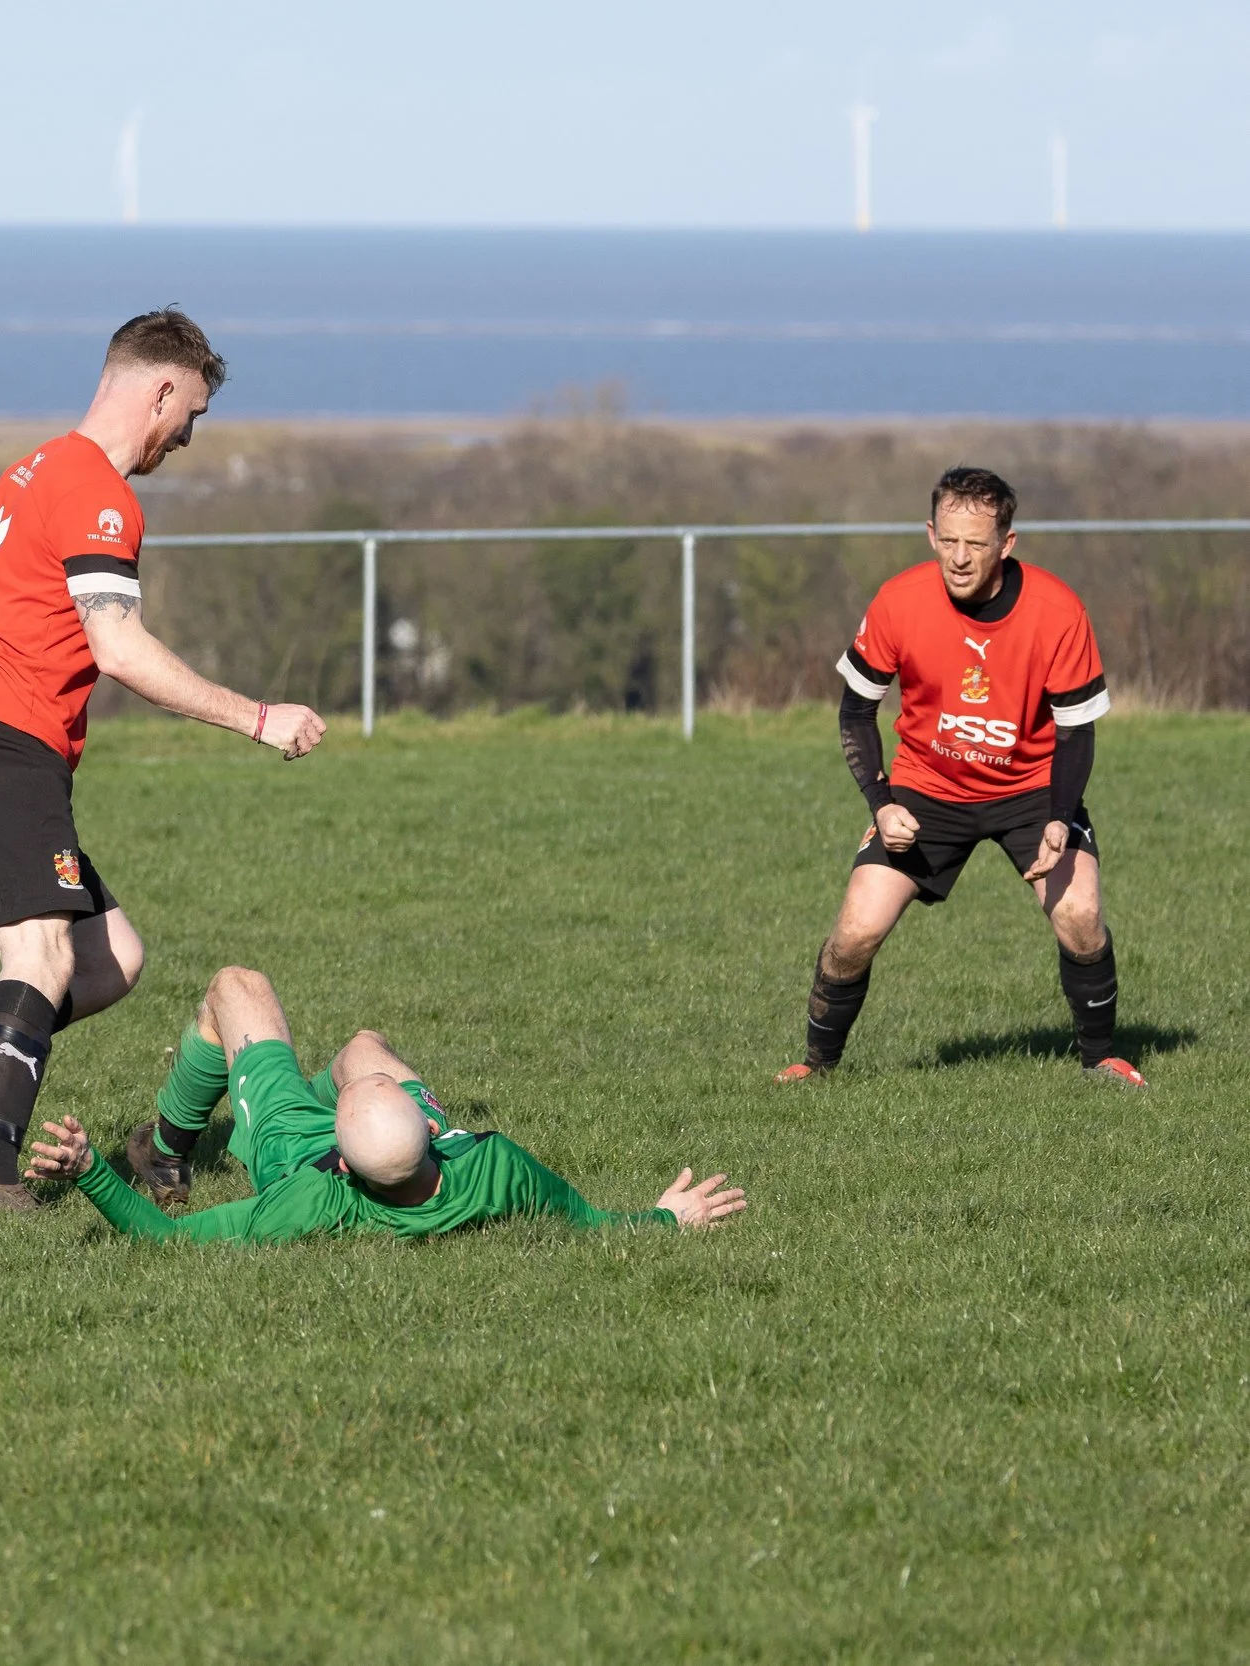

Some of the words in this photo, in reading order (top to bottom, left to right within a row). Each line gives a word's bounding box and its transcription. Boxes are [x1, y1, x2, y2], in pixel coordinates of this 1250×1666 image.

[101, 535, 122, 543] ROYAL
[937, 712, 1018, 748] PSS
[931, 739, 962, 761] AUTO
[964, 750, 1013, 766] CENTRE
